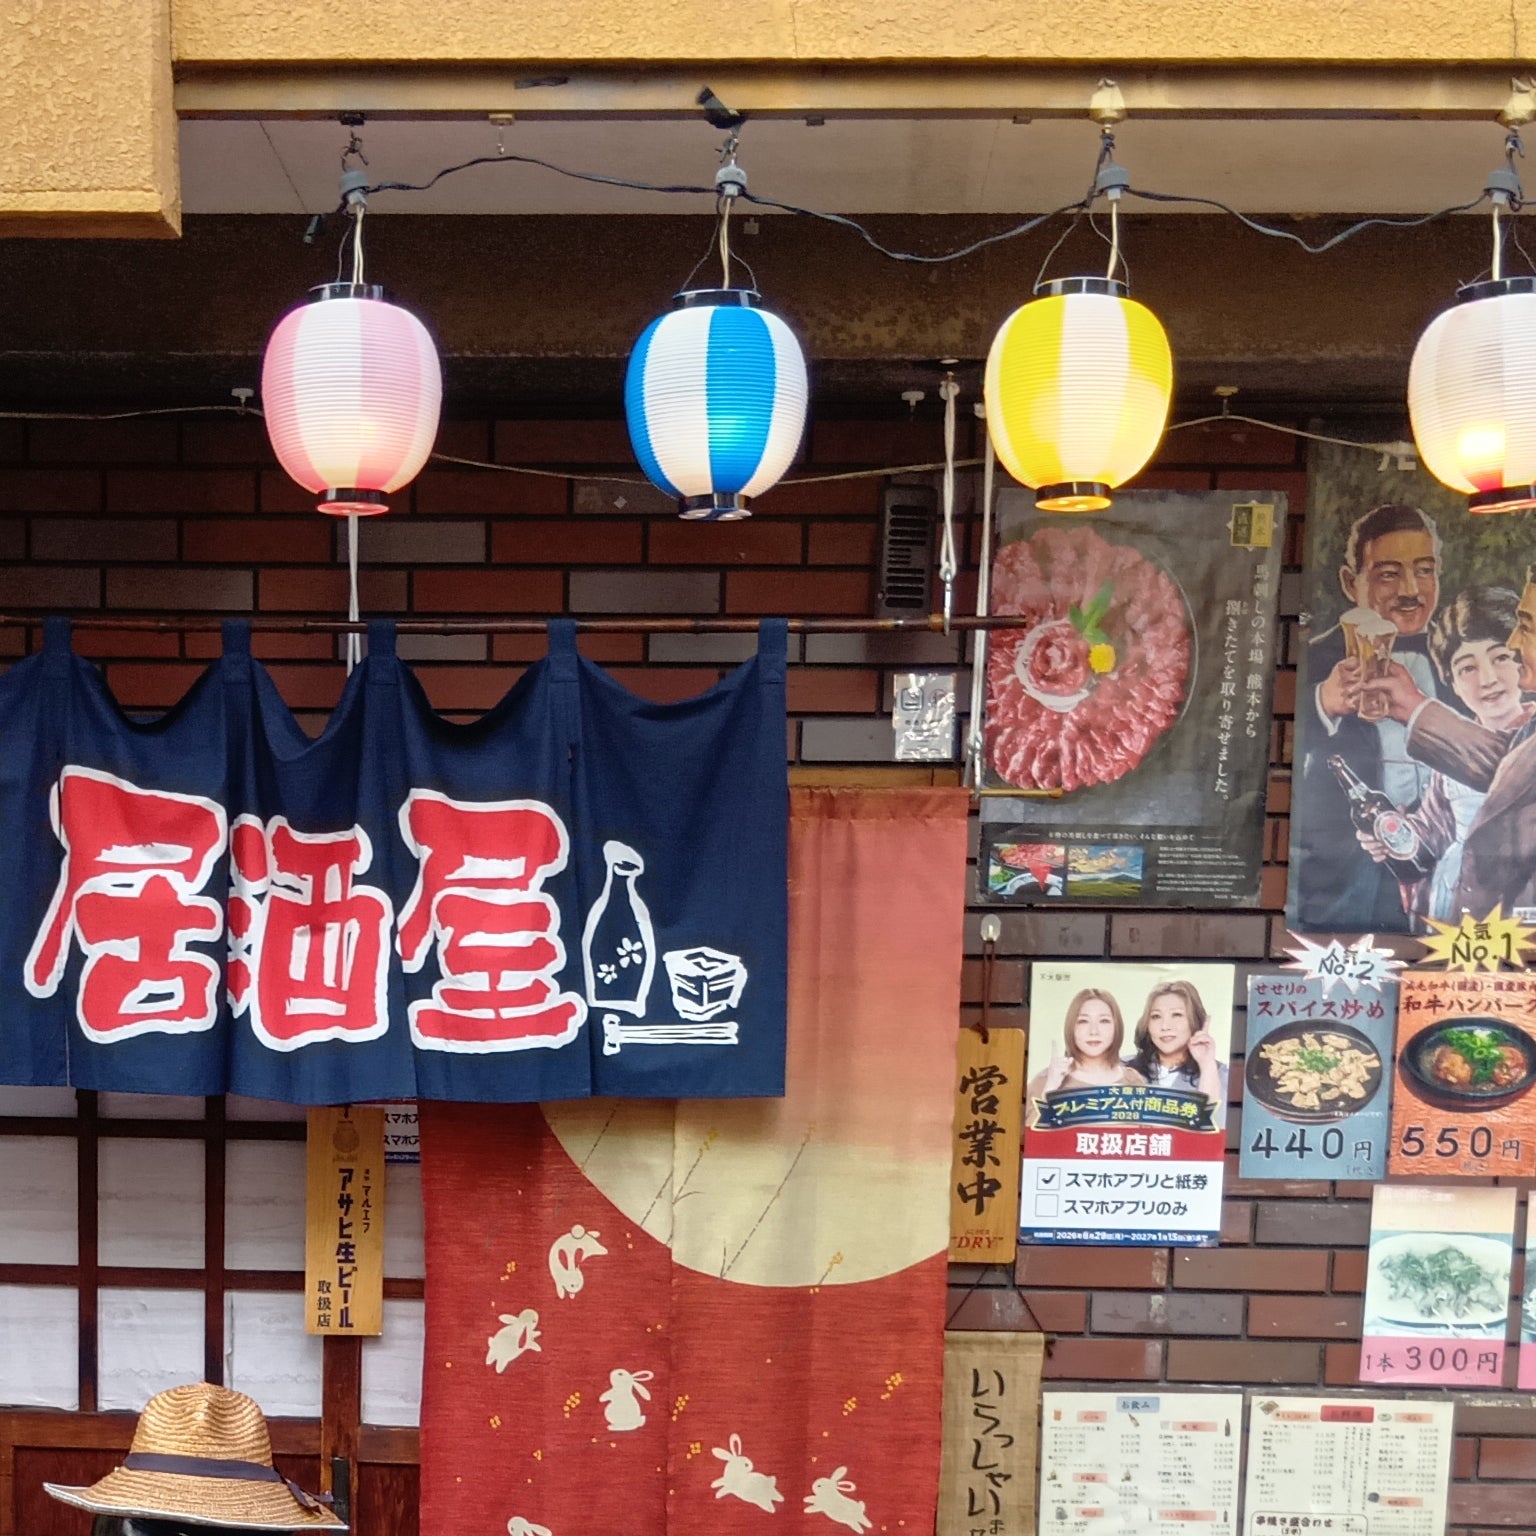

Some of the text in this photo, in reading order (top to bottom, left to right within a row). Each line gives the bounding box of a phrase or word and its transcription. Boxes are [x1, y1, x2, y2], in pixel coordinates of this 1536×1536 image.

[24, 764, 588, 1054] 居酒屋
[1455, 922, 1492, 941] 人気
[1326, 948, 1358, 966] 人気
[1451, 933, 1512, 964] No.1
[1318, 957, 1375, 981] No.2
[1255, 982, 1307, 996] せせりの
[1052, 1096, 1199, 1119] プレミアム付商品券
[957, 1065, 1008, 1216] 営業中
[1076, 1132, 1173, 1158] 取扱店舗
[1251, 1128, 1373, 1162] 440円
[1400, 1126, 1521, 1160] 550円
[1065, 1172, 1208, 1190] スマホアプリと紙券
[1064, 1199, 1188, 1216] スマホアプリのみ
[336, 1168, 358, 1329] アサヒ生ビール
[317, 1280, 332, 1328] 取扱店
[1366, 1346, 1498, 1374] 1本 300円
